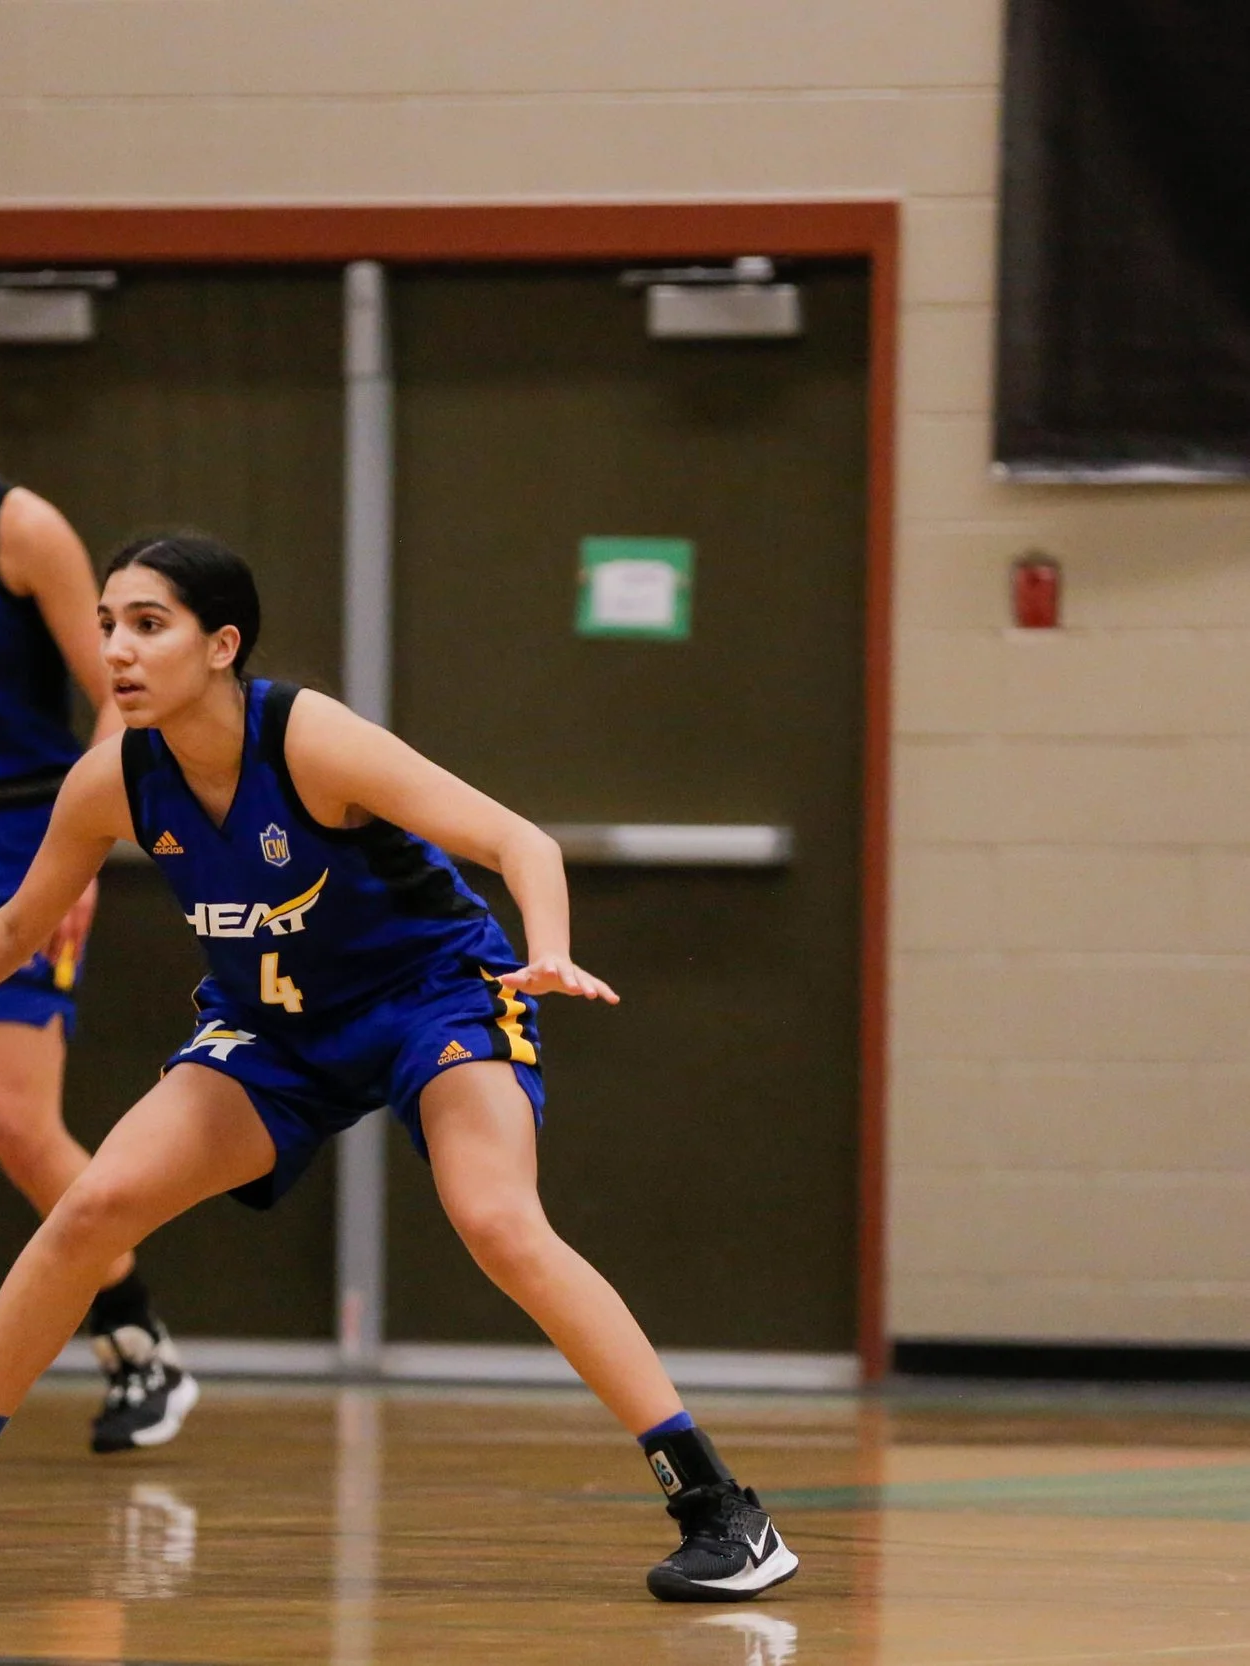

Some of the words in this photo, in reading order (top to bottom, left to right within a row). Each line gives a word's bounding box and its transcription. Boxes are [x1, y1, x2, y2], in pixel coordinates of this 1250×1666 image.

[153, 845, 184, 854] adidas
[265, 839, 287, 859] CW
[261, 952, 303, 1013] 4
[437, 1050, 473, 1066] adidas
